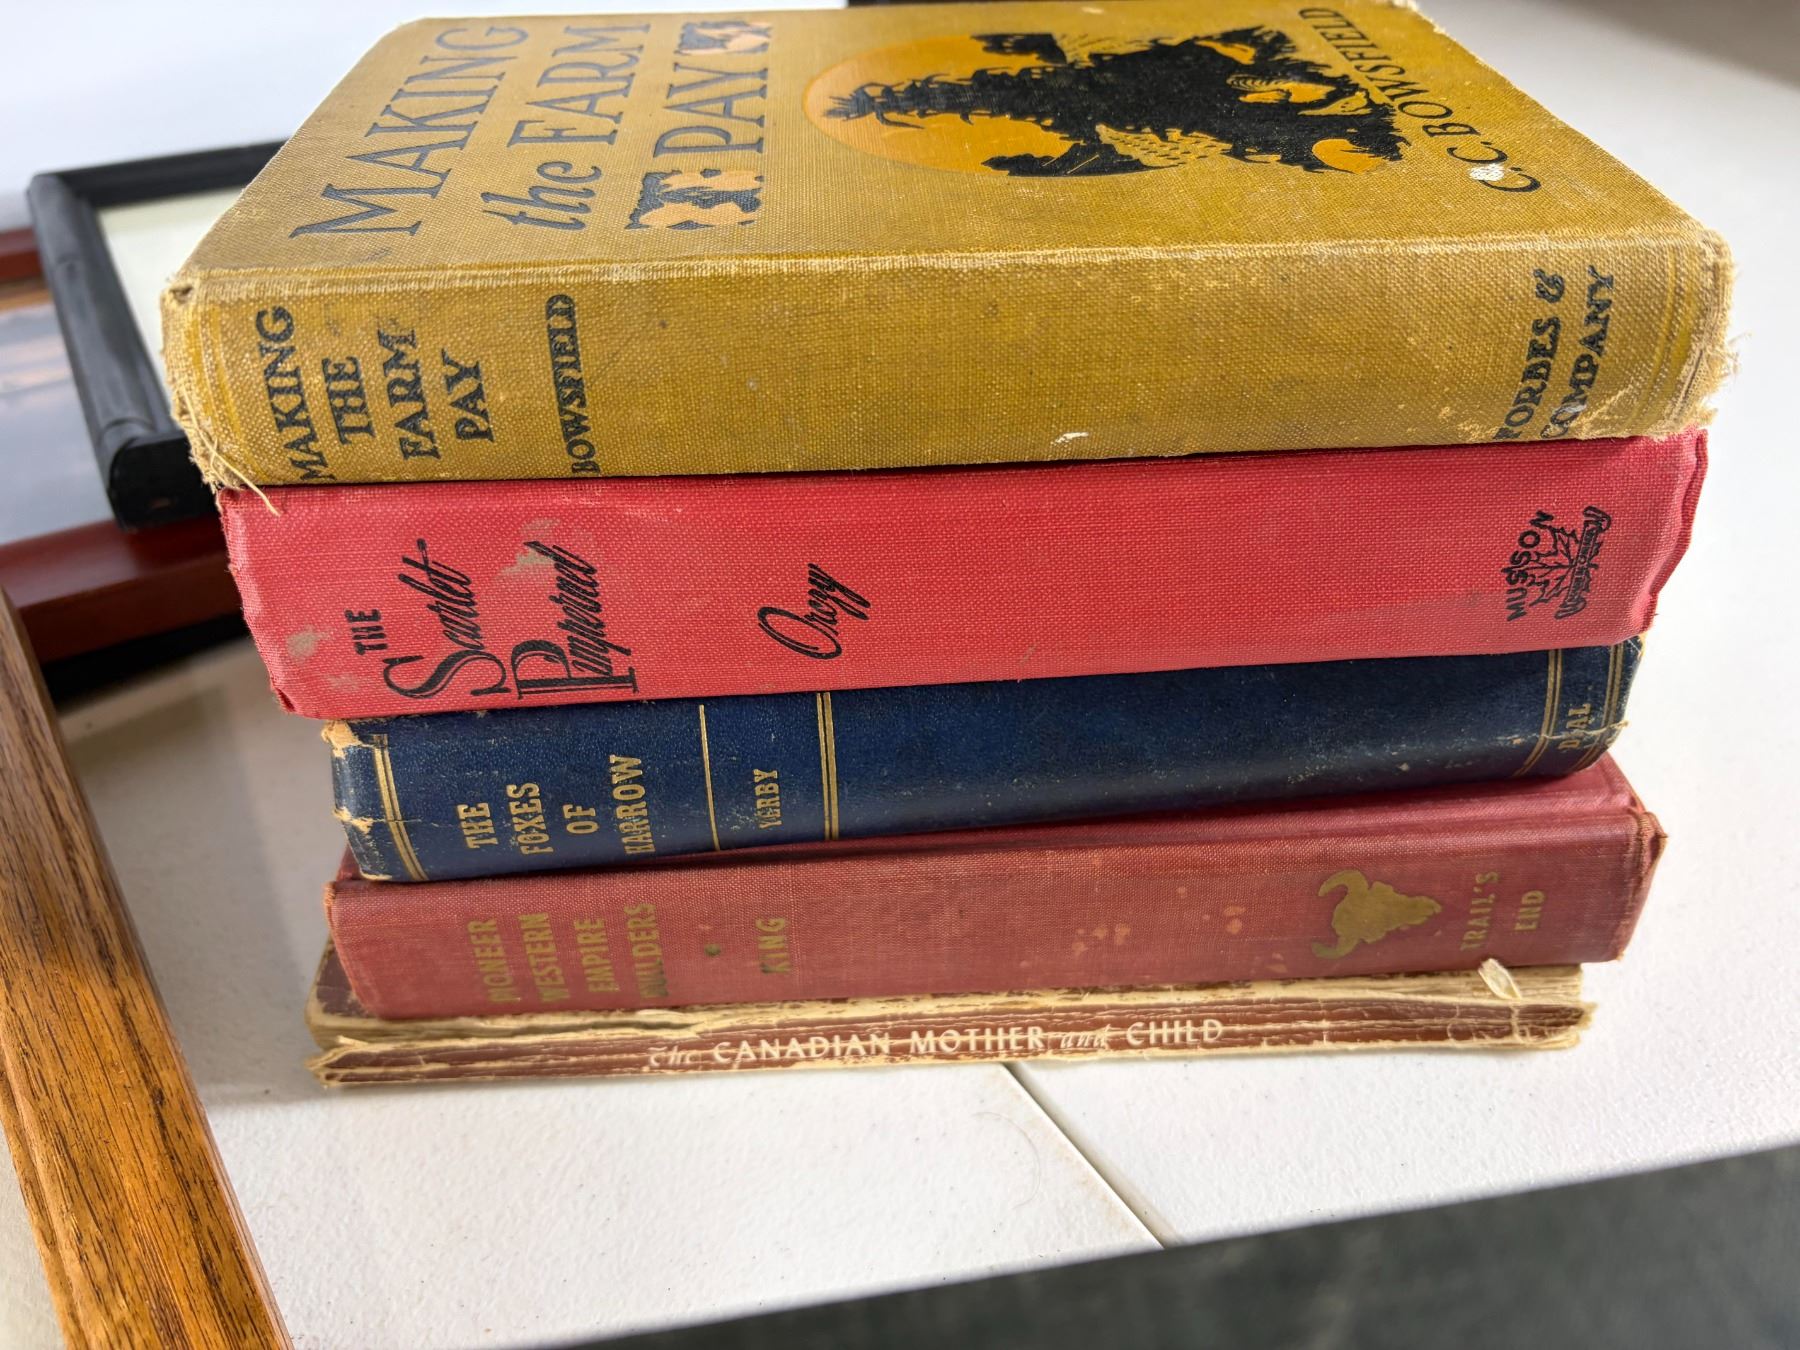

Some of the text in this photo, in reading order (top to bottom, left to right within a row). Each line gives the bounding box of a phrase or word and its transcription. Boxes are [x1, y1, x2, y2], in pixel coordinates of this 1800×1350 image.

[289, 26, 529, 238] MAKING
[481, 22, 652, 231] the FARM
[654, 62, 769, 159] PAY
[256, 305, 337, 482] MAKING
[321, 355, 375, 445] THE
[377, 328, 441, 461] FARM
[441, 348, 494, 443] PAY
[546, 294, 599, 475] BOWSFIELD
[1494, 267, 1566, 440] FORBES &
[1540, 265, 1614, 440] COMPANY
[1505, 510, 1556, 622] MUSSON
[345, 609, 384, 655] THE
[383, 538, 507, 699] Scarlet
[511, 540, 638, 701] Pimpernel
[456, 802, 500, 849] THE
[506, 781, 554, 855] FOXES
[562, 802, 599, 836] OF
[609, 754, 657, 855] HARROW
[753, 768, 783, 829] YERBY
[518, 912, 569, 1003] WESTERN
[574, 917, 620, 994] EMPIRE
[755, 917, 791, 975] KING
[1461, 871, 1500, 952] TRAIL'S
[1514, 889, 1546, 932] END
[713, 1032, 890, 1063] CANADIAN
[910, 1025, 1045, 1054] MOTHER
[1060, 1024, 1111, 1050] and
[1126, 1019, 1222, 1046] CHILD
